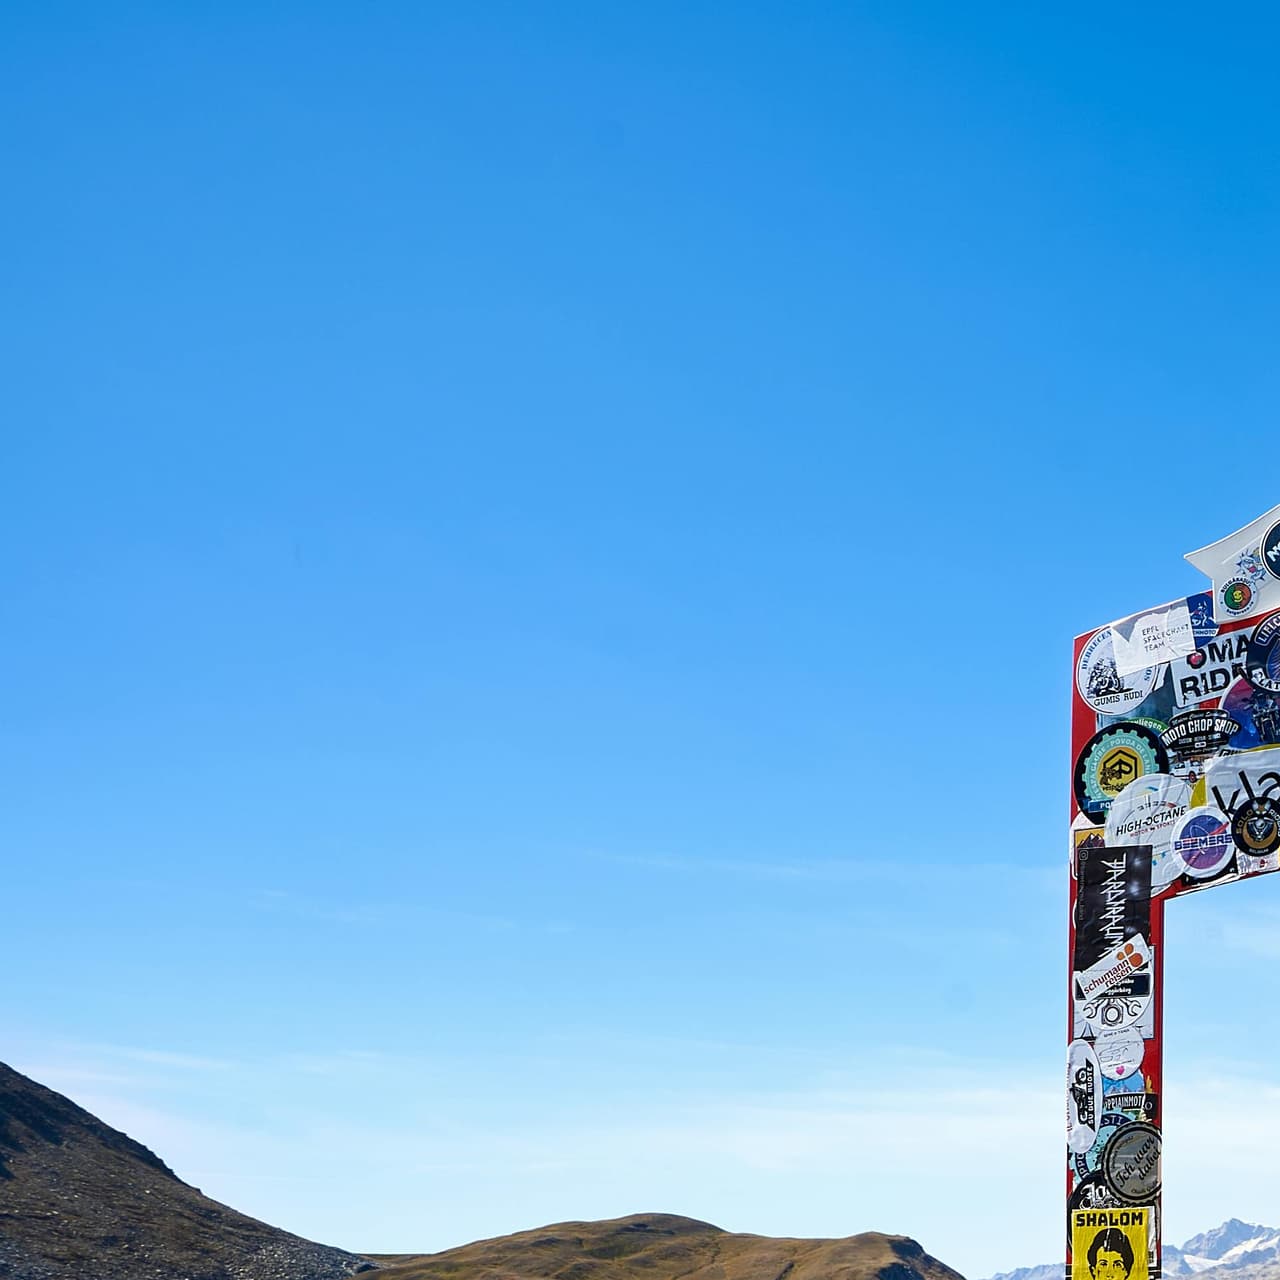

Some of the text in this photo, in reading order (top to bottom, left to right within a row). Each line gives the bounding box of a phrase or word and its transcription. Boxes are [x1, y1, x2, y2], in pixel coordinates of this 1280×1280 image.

[1093, 690, 1143, 707] GUMIS RUDI
[1161, 718, 1240, 747] MOTO CHOP SHOP
[1116, 806, 1187, 836] HIGH-OCTANE
[1236, 809, 1253, 834] SOLO
[1175, 834, 1233, 852] BEEMERS
[1083, 959, 1130, 995] schumann
[1105, 966, 1133, 988] reisen
[1115, 1135, 1155, 1188] Ich war
[1138, 1145, 1161, 1181] dabei
[1076, 1212, 1143, 1227] SHALOM
